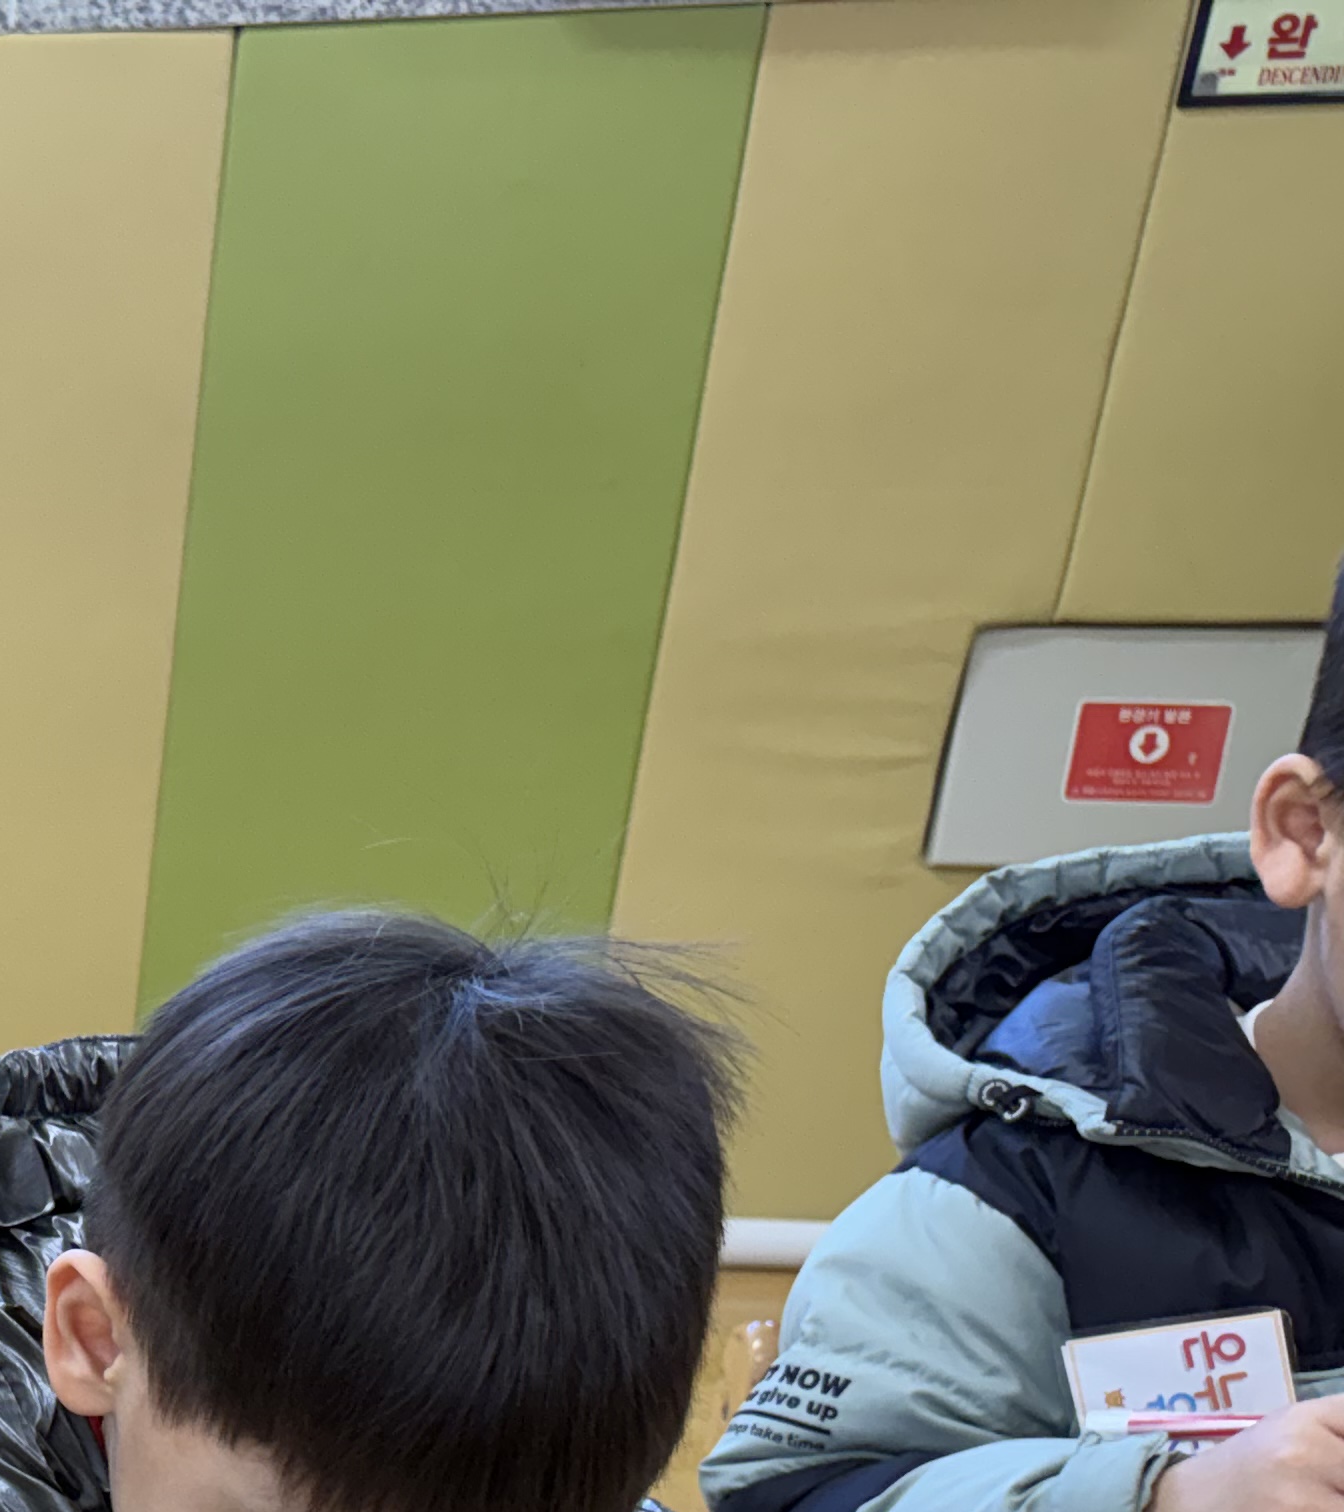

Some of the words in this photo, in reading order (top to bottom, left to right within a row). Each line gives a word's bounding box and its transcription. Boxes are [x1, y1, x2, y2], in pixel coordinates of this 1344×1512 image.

[1256, 65, 1344, 87] DESCENDI
[778, 1364, 853, 1399] NOW
[756, 1386, 802, 1410] give
[806, 1400, 839, 1423] up
[749, 1423, 784, 1444] take
[786, 1432, 826, 1452] time
